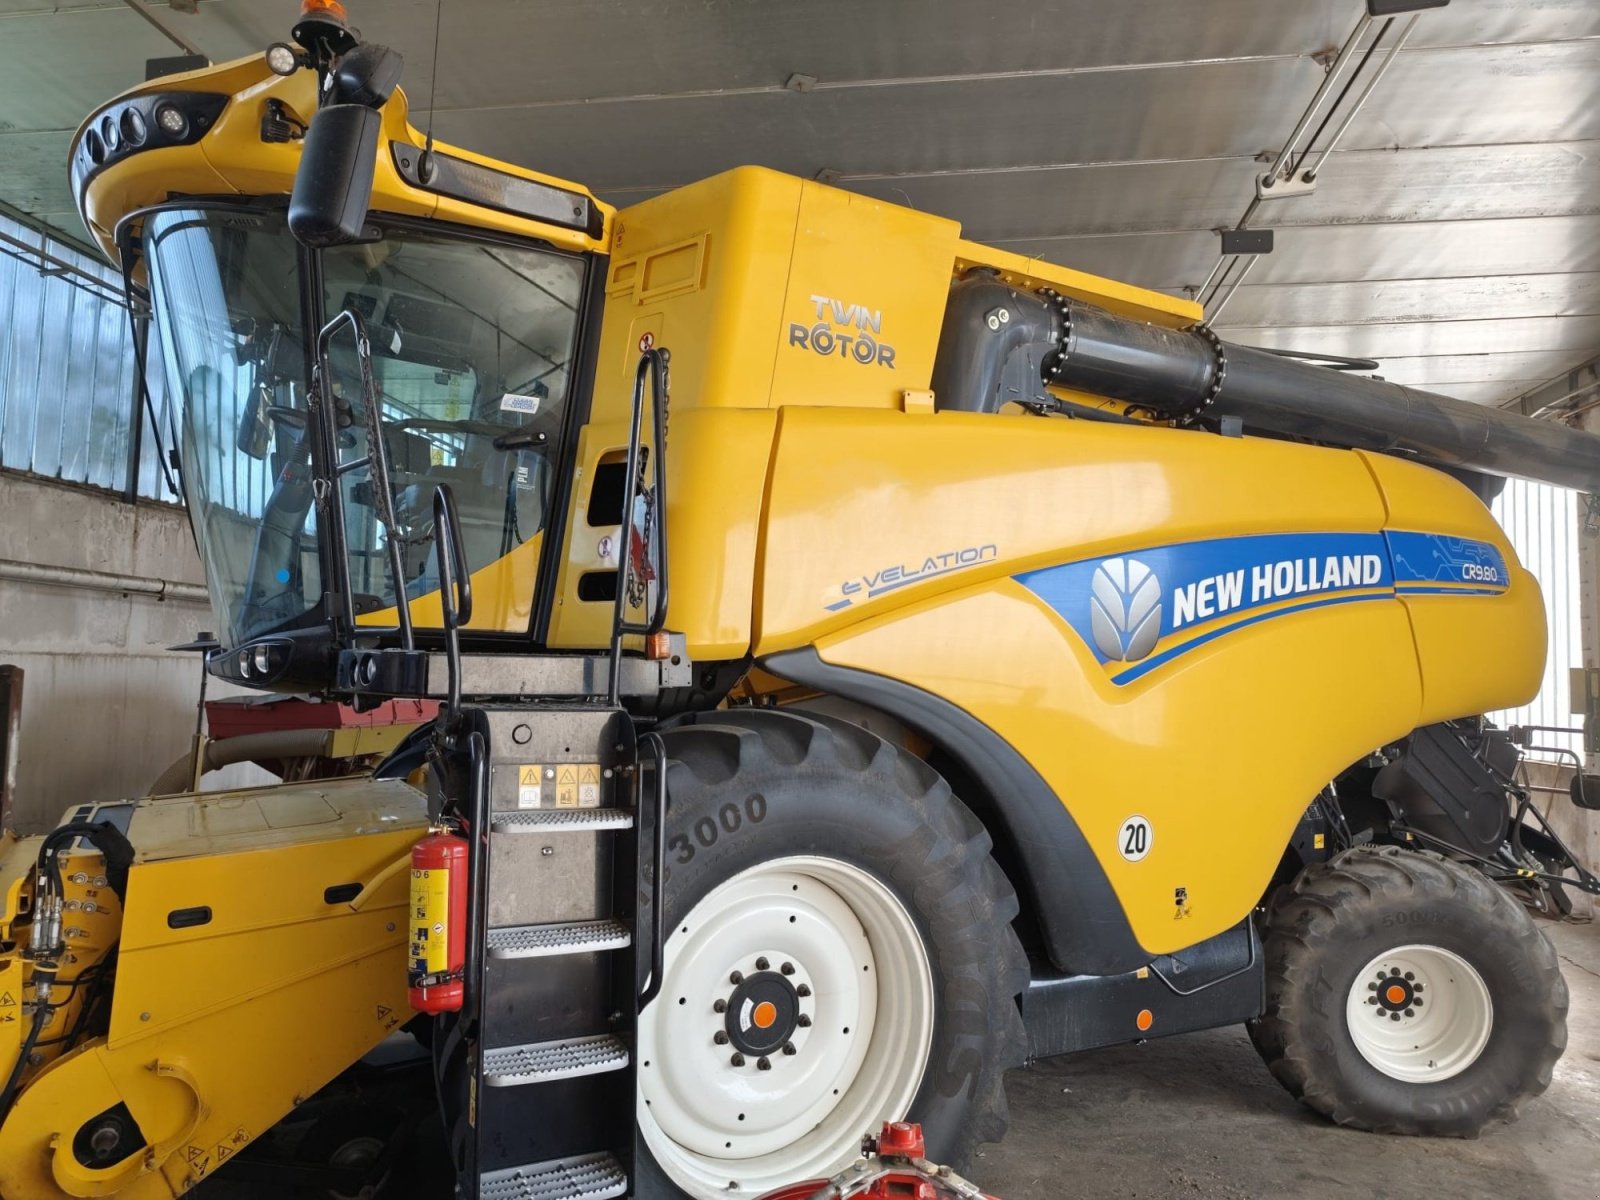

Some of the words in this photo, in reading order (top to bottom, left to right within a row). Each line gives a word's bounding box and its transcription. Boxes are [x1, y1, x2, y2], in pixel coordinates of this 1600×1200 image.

[809, 294, 881, 334] TWIN
[789, 322, 896, 369] ROTOR
[1172, 569, 1244, 628] NEW
[1251, 554, 1382, 602] HOLLAND
[1462, 563, 1498, 582] CR9.80
[667, 792, 767, 865] 3000
[1124, 823, 1147, 854] 20
[423, 870, 430, 879] 6
